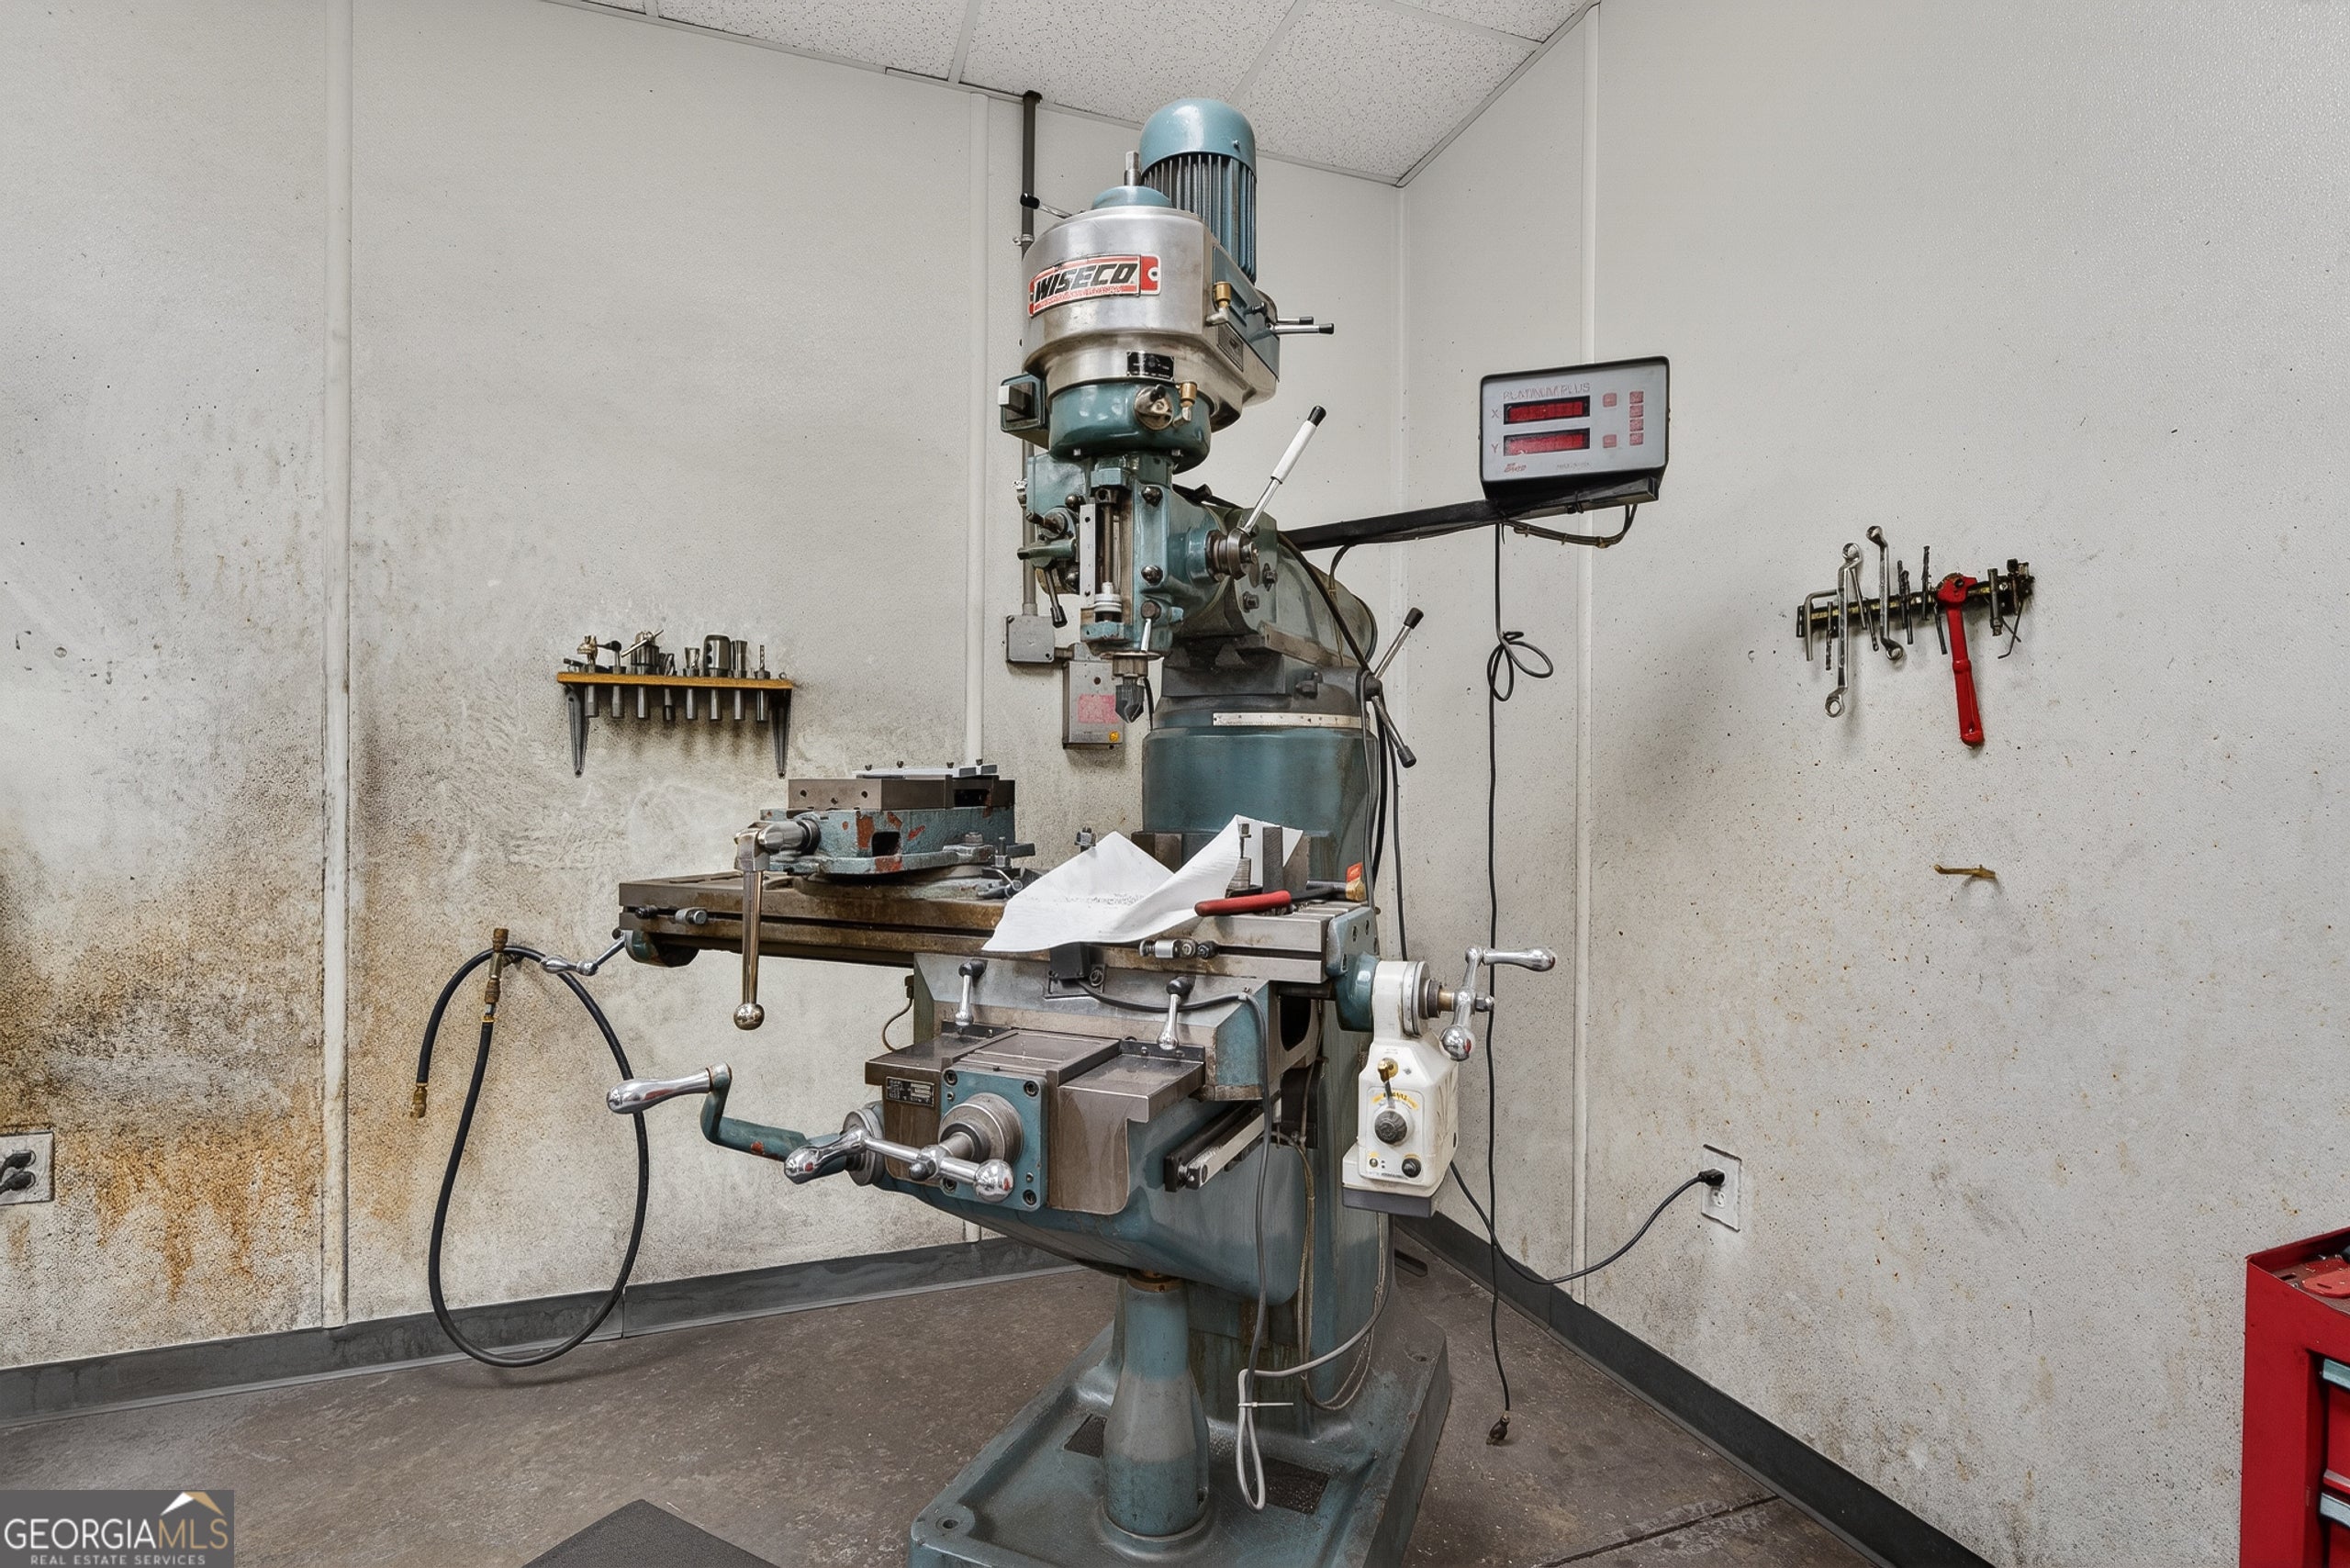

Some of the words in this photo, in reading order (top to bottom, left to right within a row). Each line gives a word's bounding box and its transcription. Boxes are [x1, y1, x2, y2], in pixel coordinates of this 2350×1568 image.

[1035, 263, 1138, 303] WISECO
[1503, 385, 1560, 400] PLATINUM
[1561, 382, 1591, 395] PLUS
[1491, 409, 1499, 419] X
[1491, 443, 1499, 454] Y
